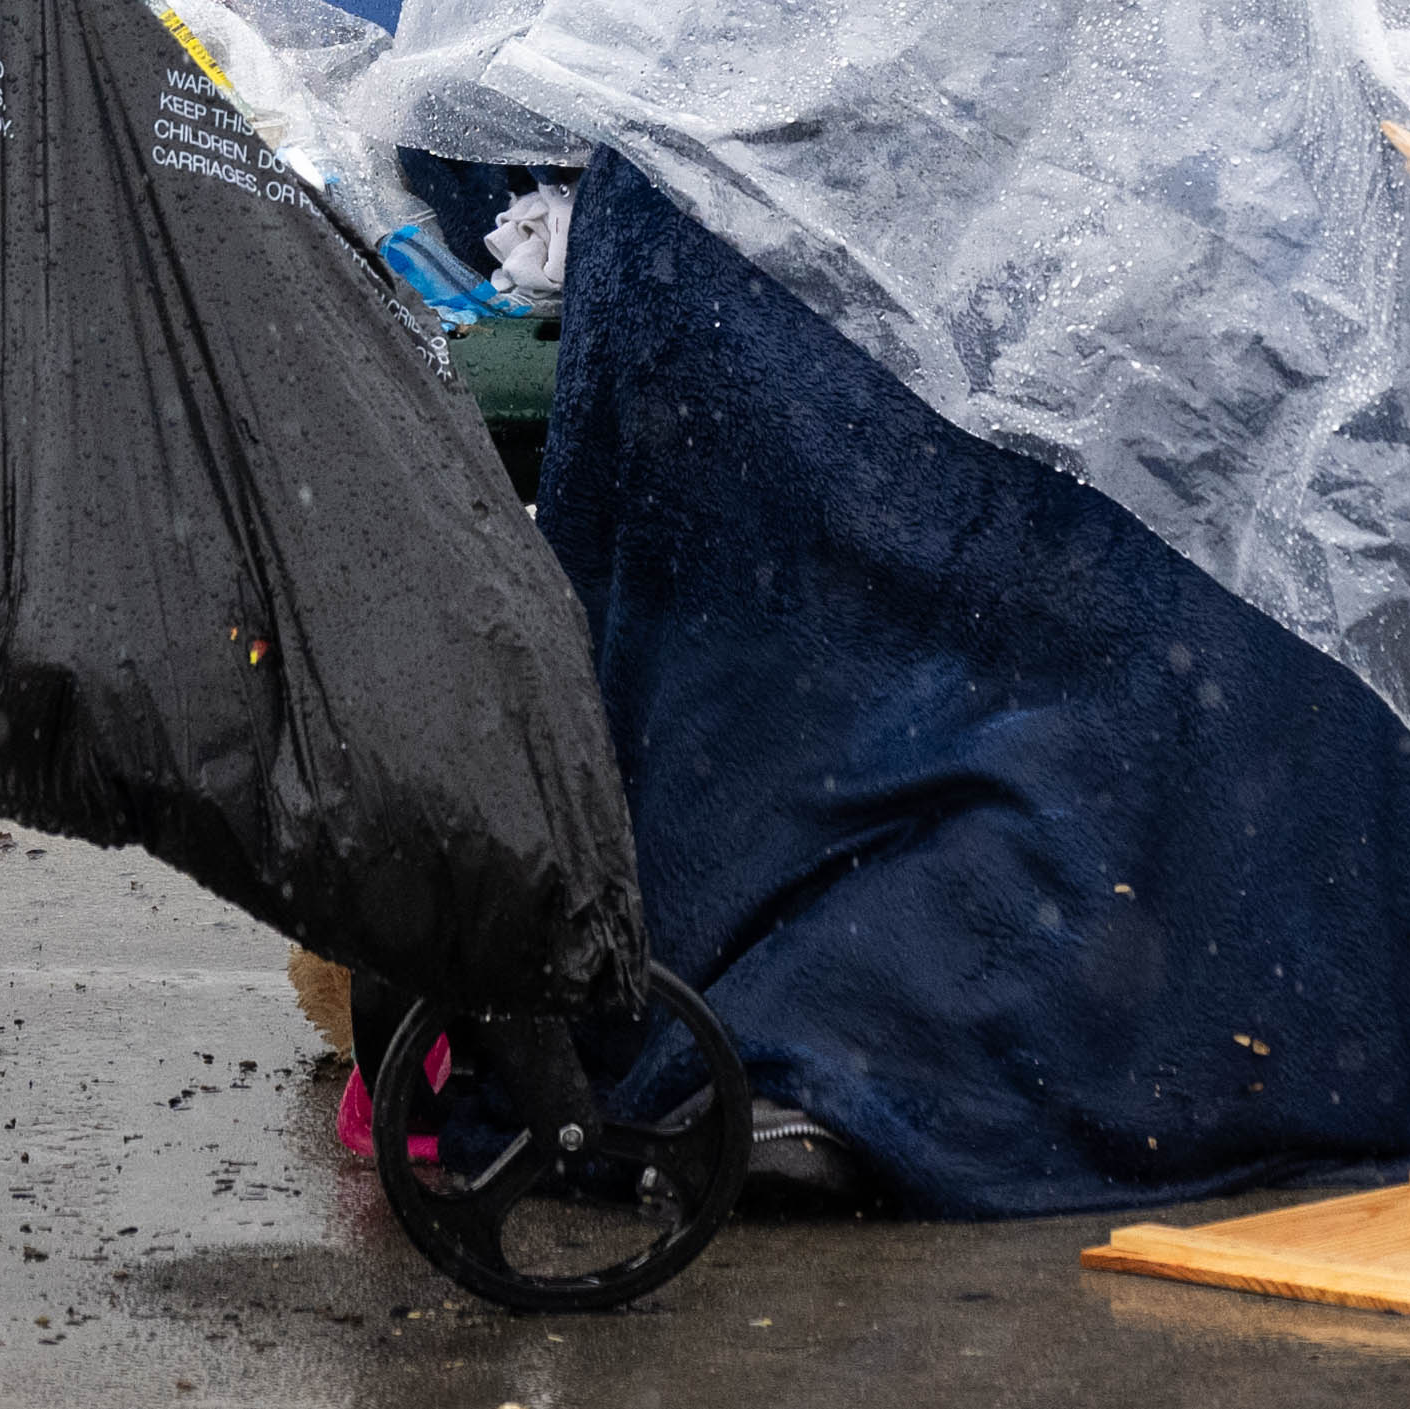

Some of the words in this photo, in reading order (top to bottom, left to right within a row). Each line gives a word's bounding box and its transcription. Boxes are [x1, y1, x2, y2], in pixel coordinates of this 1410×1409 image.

[160, 92, 207, 120] KEEP
[211, 108, 255, 137] THIS
[154, 119, 251, 165] CHILDREN.
[152, 146, 262, 197] CARRIAGES,
[266, 181, 295, 205] OR
